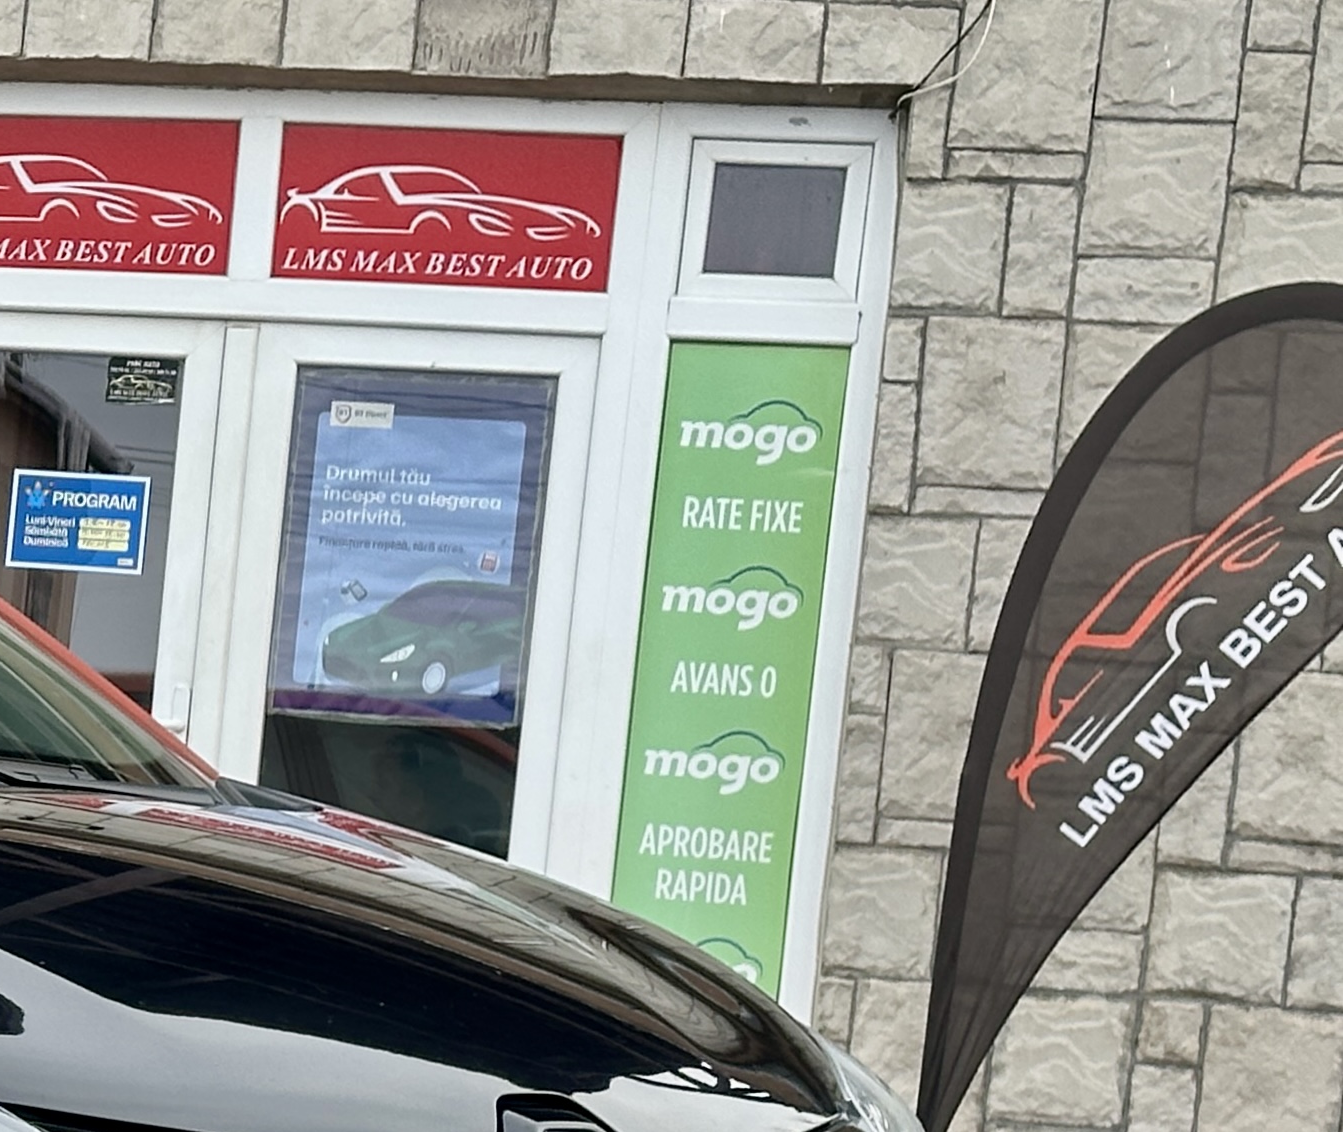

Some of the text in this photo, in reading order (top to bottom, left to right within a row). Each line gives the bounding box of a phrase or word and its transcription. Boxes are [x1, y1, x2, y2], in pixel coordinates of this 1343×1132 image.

[54, 239, 132, 263] BEST
[132, 242, 216, 267] AUTO
[282, 248, 593, 281] LMS MAX BEST AUTO
[679, 420, 817, 466] mogo
[326, 464, 395, 484] Drumul
[52, 490, 137, 511] PROGRAM
[390, 491, 413, 505] cu
[417, 490, 502, 512] alegerea
[682, 495, 804, 533] RATE FIXE
[661, 585, 799, 631] mogo
[670, 660, 754, 697] AVANS
[1059, 553, 1326, 847] LMS MAX BEST
[643, 749, 780, 795] mogo
[638, 822, 775, 864] APROBARE
[655, 867, 748, 906] RAPIDA
